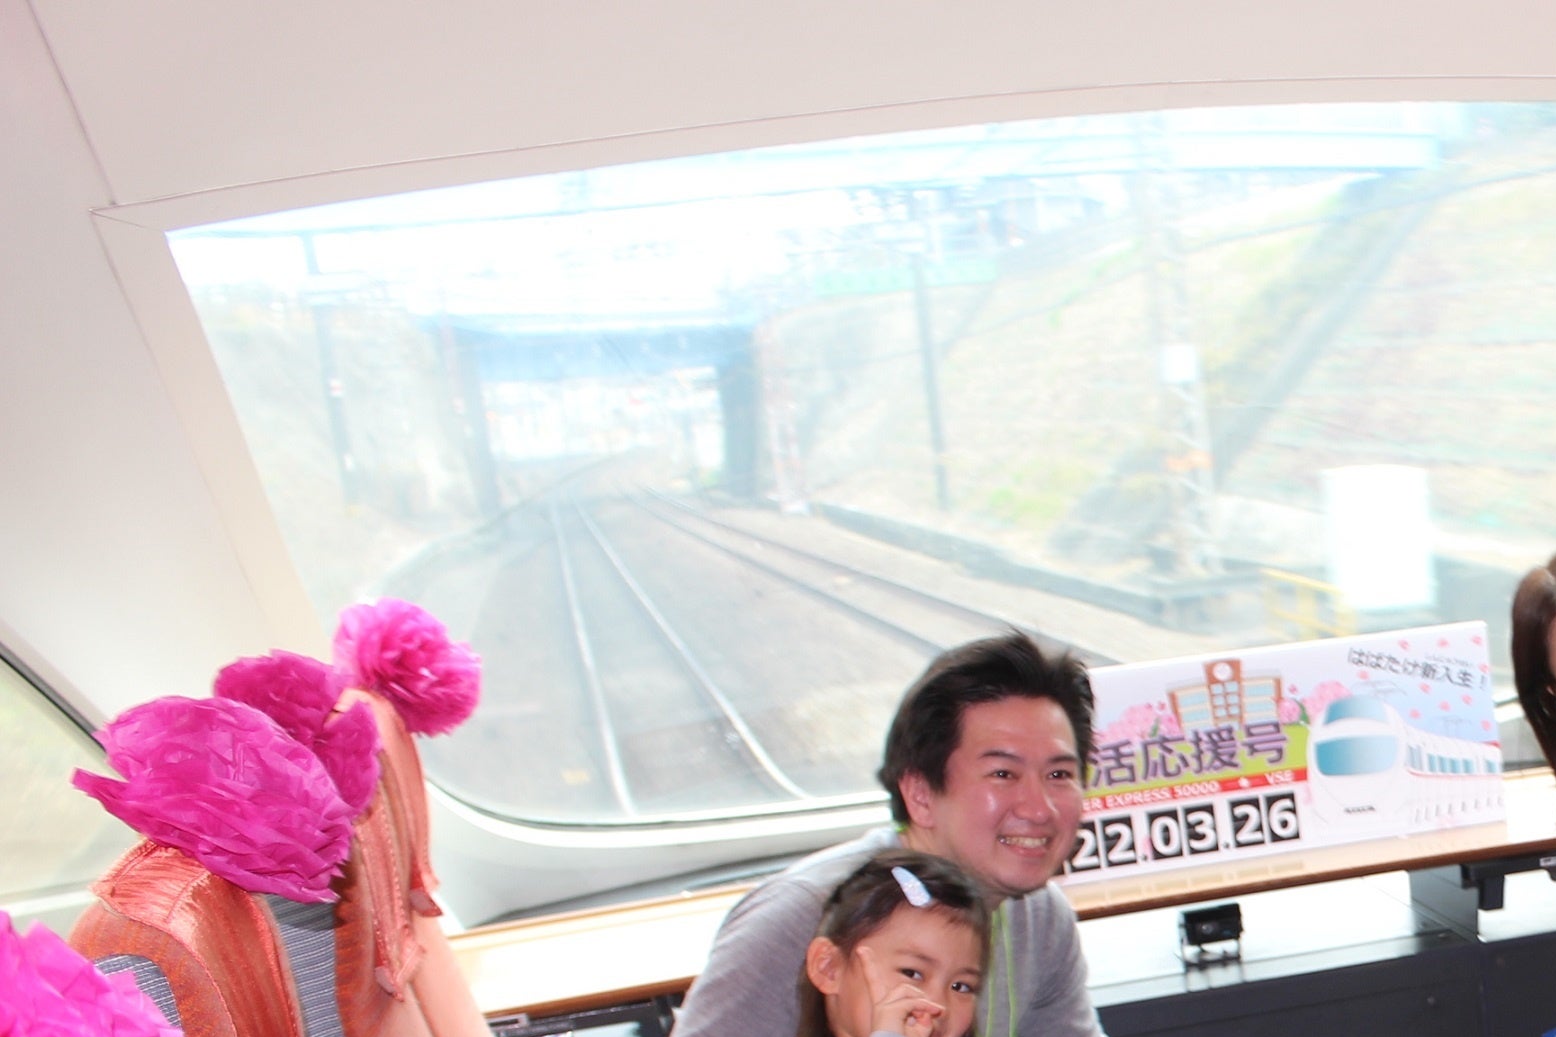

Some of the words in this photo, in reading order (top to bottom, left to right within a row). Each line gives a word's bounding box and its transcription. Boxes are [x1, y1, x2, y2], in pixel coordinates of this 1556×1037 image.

[1106, 785, 1171, 808] EXPRESS
[1173, 779, 1220, 798] 50000
[1264, 770, 1294, 786] VSE
